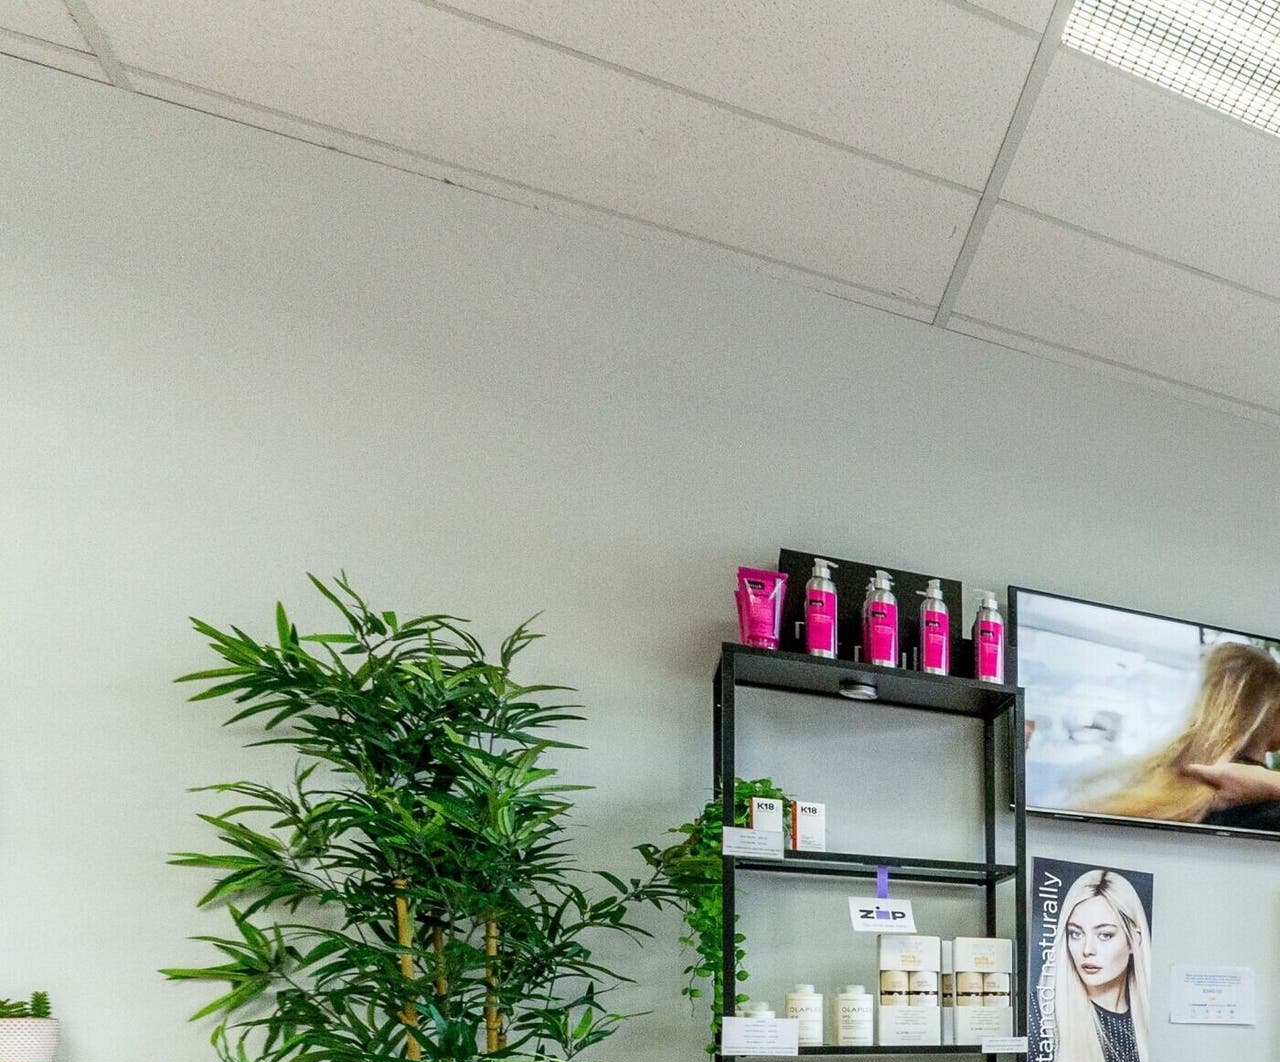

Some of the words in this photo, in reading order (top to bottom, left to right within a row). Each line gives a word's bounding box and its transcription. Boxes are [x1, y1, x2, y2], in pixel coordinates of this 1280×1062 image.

[757, 802, 775, 811] K18
[801, 806, 817, 815] K18
[859, 906, 906, 920] zip
[1039, 871, 1062, 977] naturally
[1036, 985, 1056, 1062] tamed
